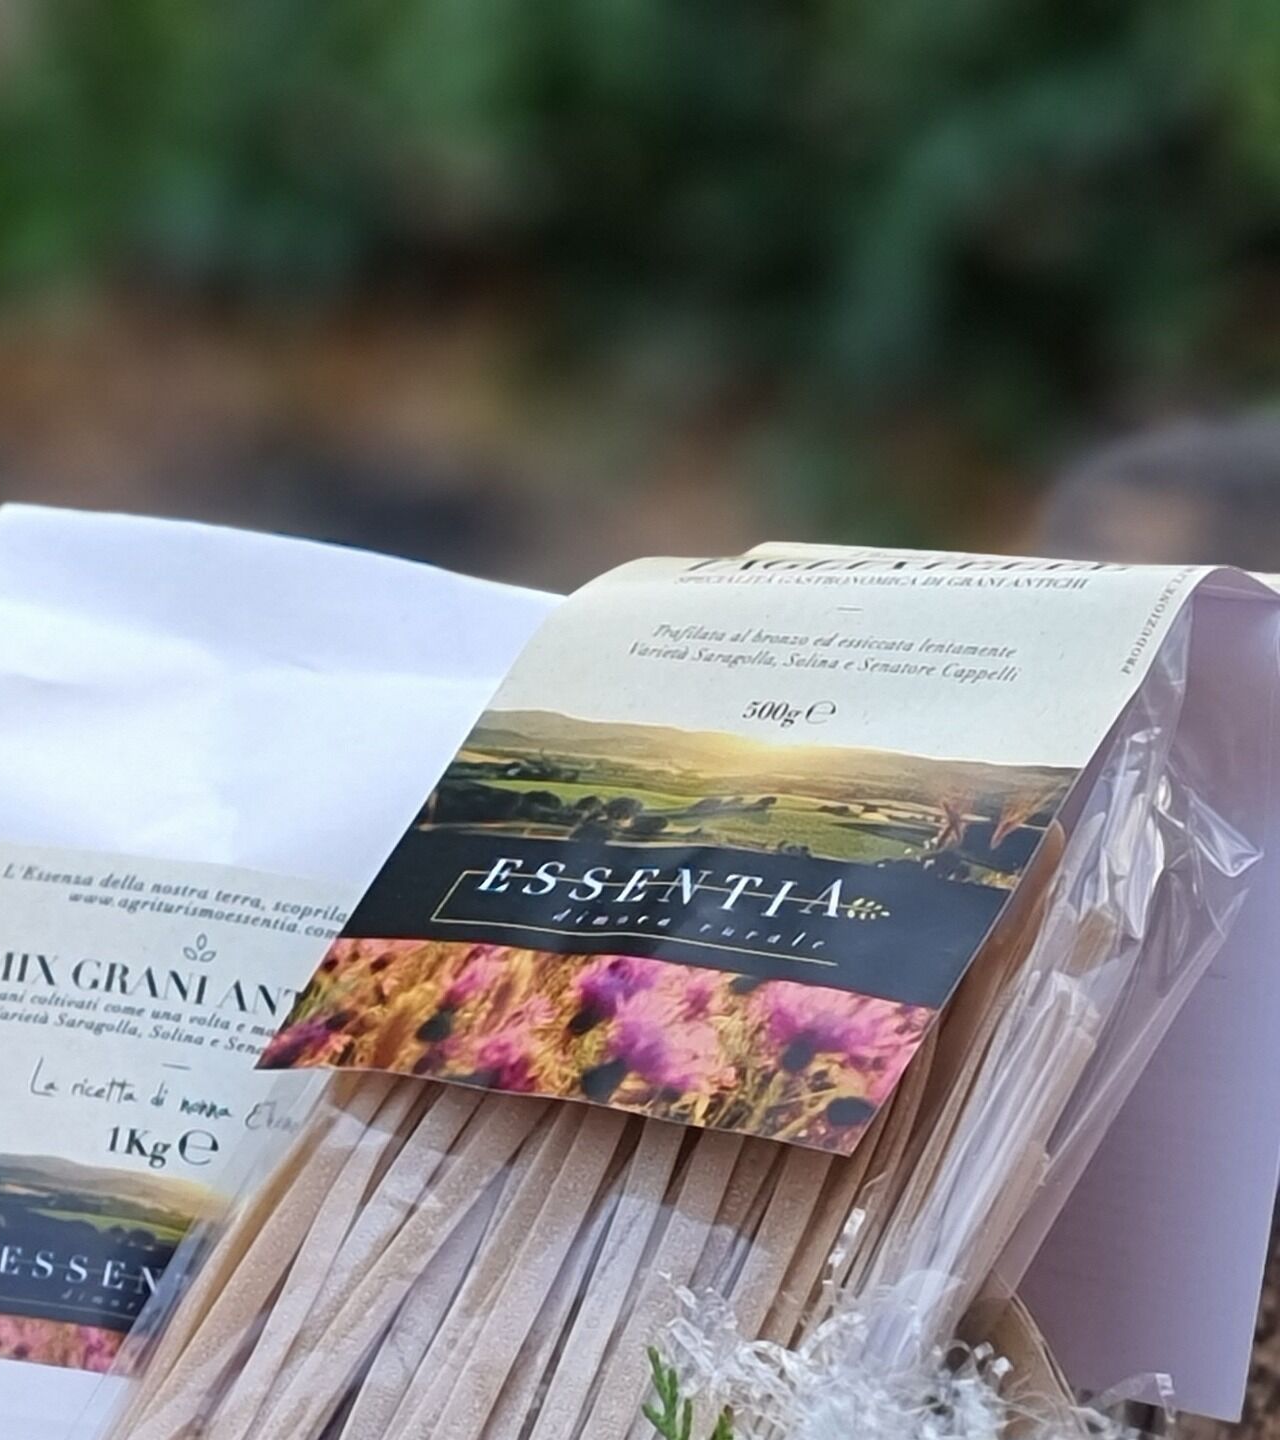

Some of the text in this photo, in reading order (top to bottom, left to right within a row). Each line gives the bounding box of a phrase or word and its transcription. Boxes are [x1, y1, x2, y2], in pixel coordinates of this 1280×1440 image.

[1007, 577, 1090, 589] ANTICHI
[652, 624, 1017, 659] Trafilata al bronzo ed essiccata lentamente
[629, 642, 1022, 684] Varietà Saragolla, Solina e Senatore Cappelli
[3, 862, 347, 925] L'Essenza della nostra terra, scoprila
[477, 857, 845, 919] ESSENTIA
[552, 908, 826, 950] dimora rurale
[71, 959, 209, 1006] GRANI
[29, 990, 99, 1013] coltivati
[103, 1001, 143, 1017] come
[150, 1008, 183, 1023] una
[188, 1012, 230, 1031] volta
[53, 1012, 143, 1039] Saragolla,
[148, 1025, 205, 1047] Solina
[29, 1057, 59, 1098] La
[71, 1076, 138, 1103] ricetta
[150, 1080, 168, 1108] di
[179, 1099, 233, 1120] nonna
[107, 1126, 173, 1170] 1Kg
